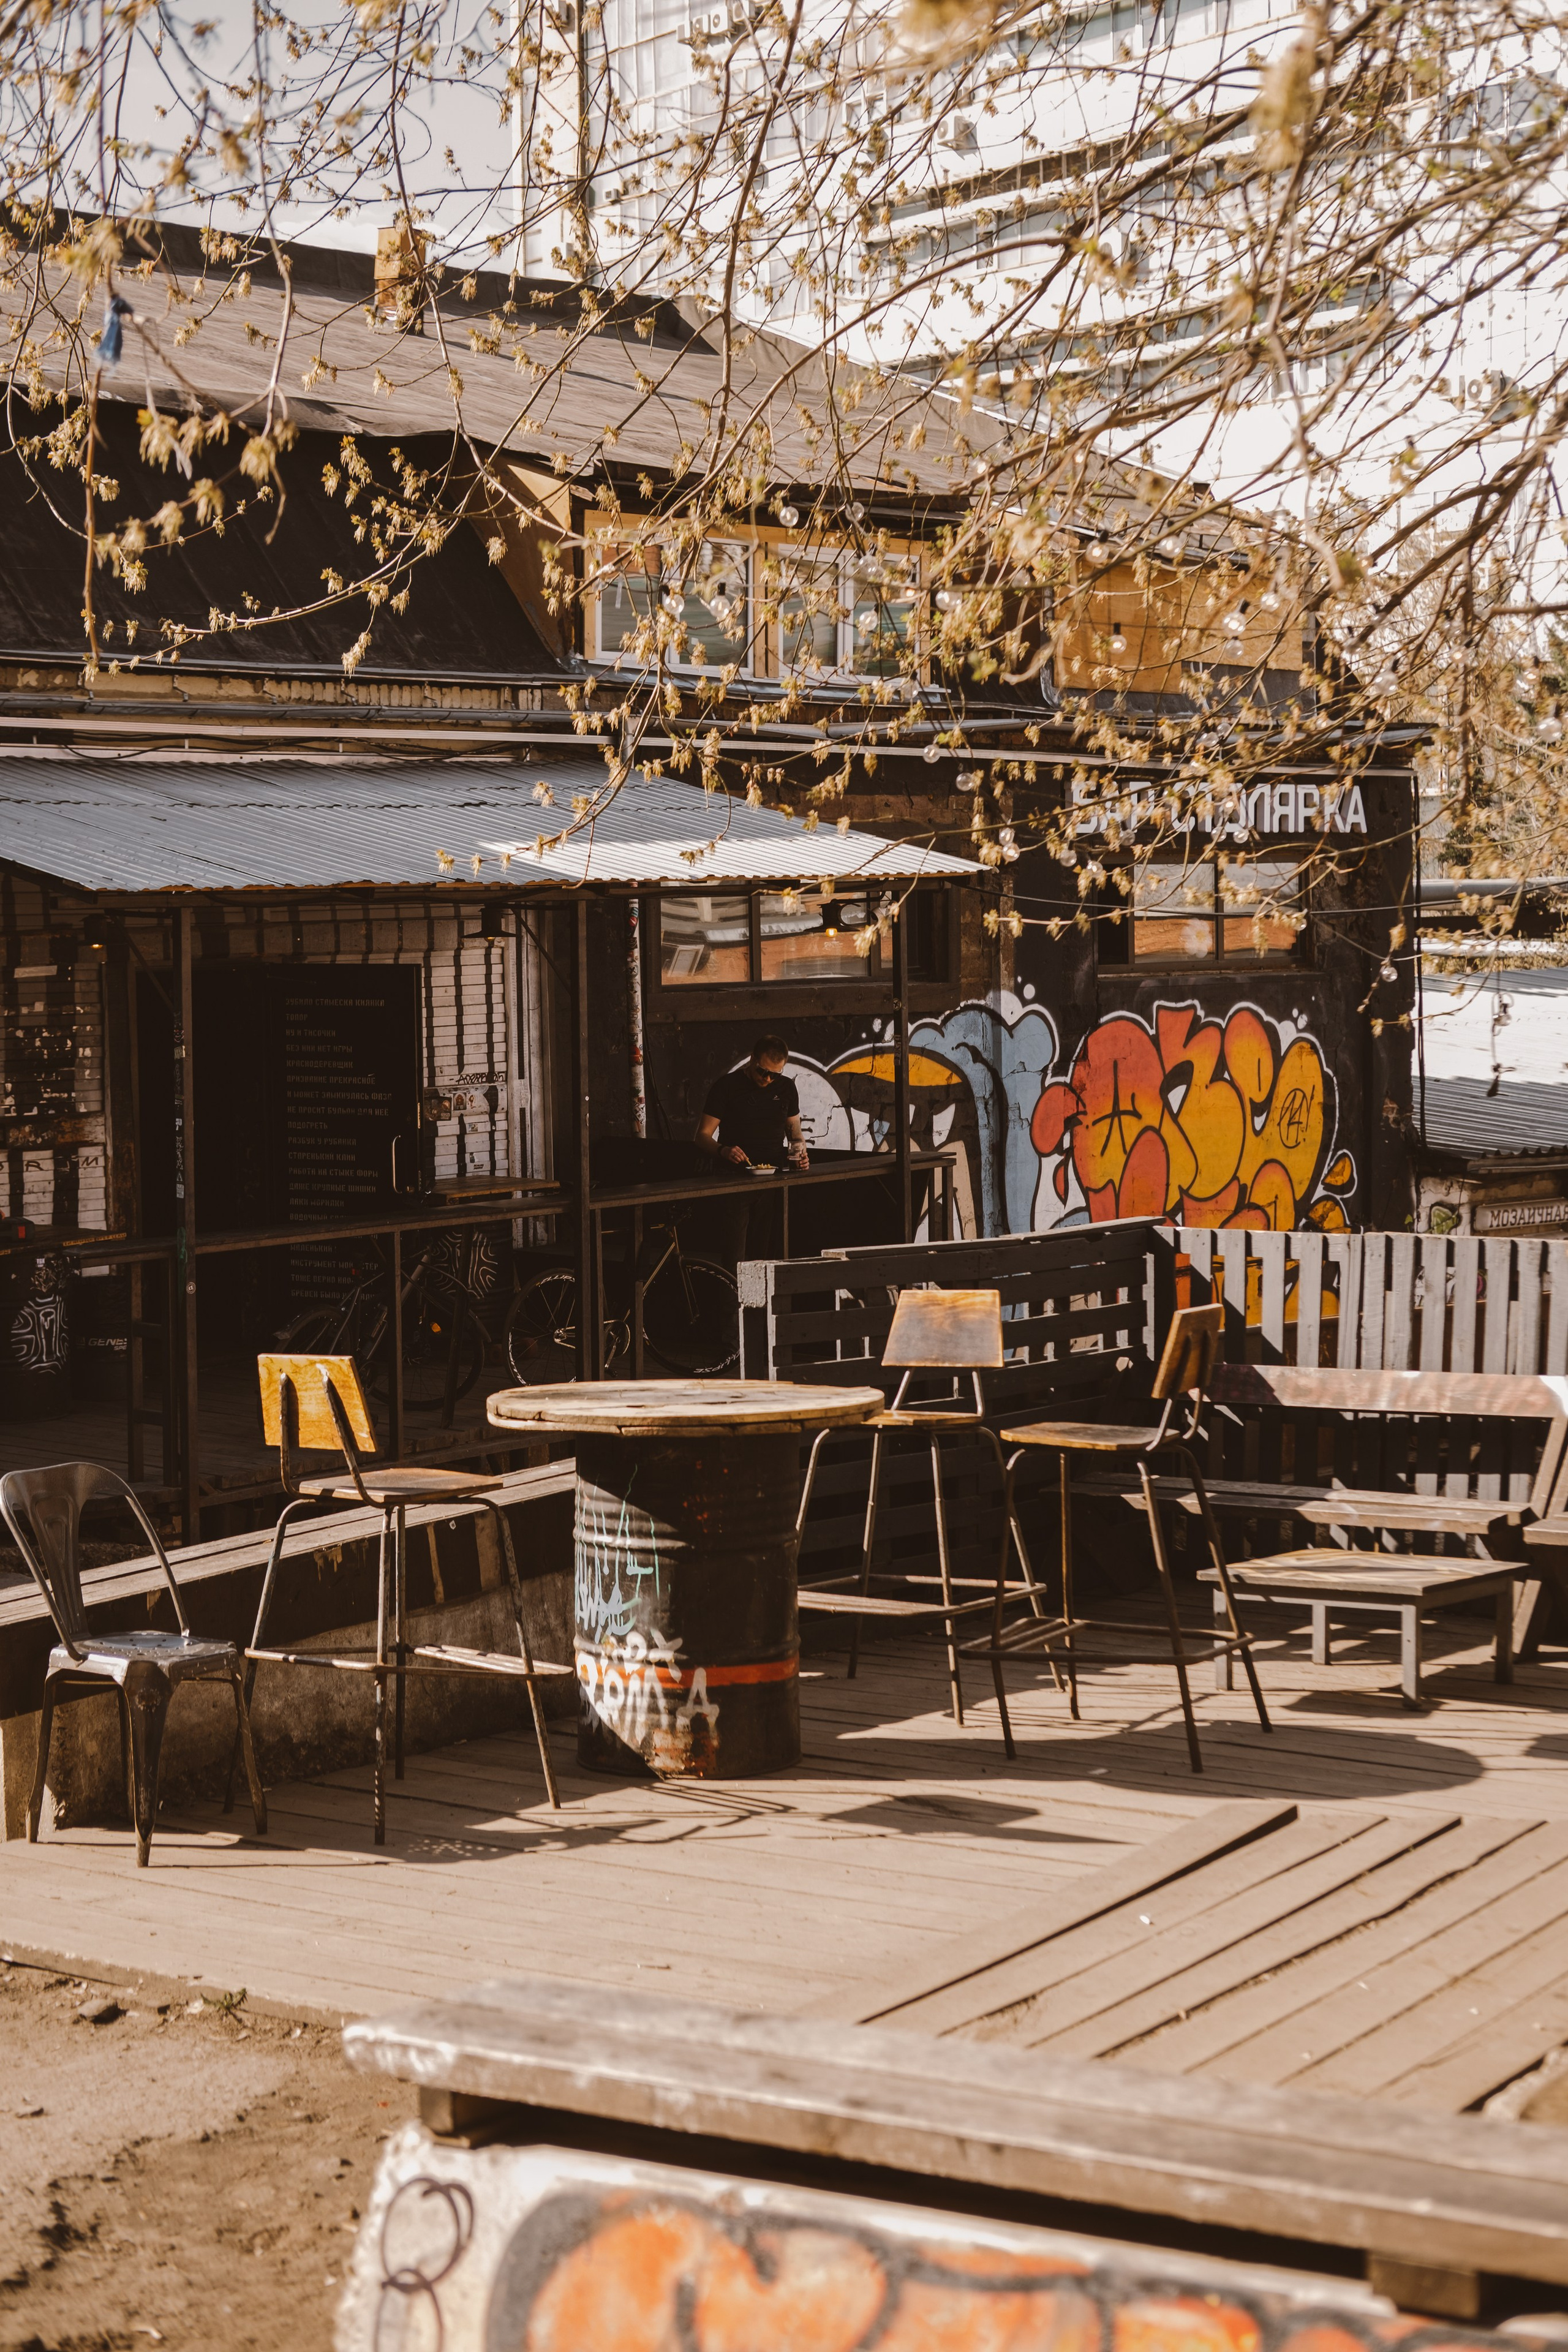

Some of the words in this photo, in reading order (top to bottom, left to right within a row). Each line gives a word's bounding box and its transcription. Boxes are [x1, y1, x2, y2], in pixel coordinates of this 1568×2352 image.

[1071, 781, 1155, 834] БАР
[1170, 781, 1368, 834] СТОЛЯРКА
[286, 1060, 353, 1069] КРАСНОДЕРЕВЩИК
[287, 1075, 327, 1084] ПРИЗВАНИЕ
[288, 1121, 328, 1130] ПОДОГРЕТЬ
[288, 1152, 334, 1161] СТАРЕНЬКИЙ
[312, 1183, 345, 1192] КРУПНЫЕ
[348, 1185, 376, 1193] ШИШКИ
[290, 1197, 308, 1206] ЛАКИ
[290, 1259, 337, 1268] ИНСТРУМЕНТ
